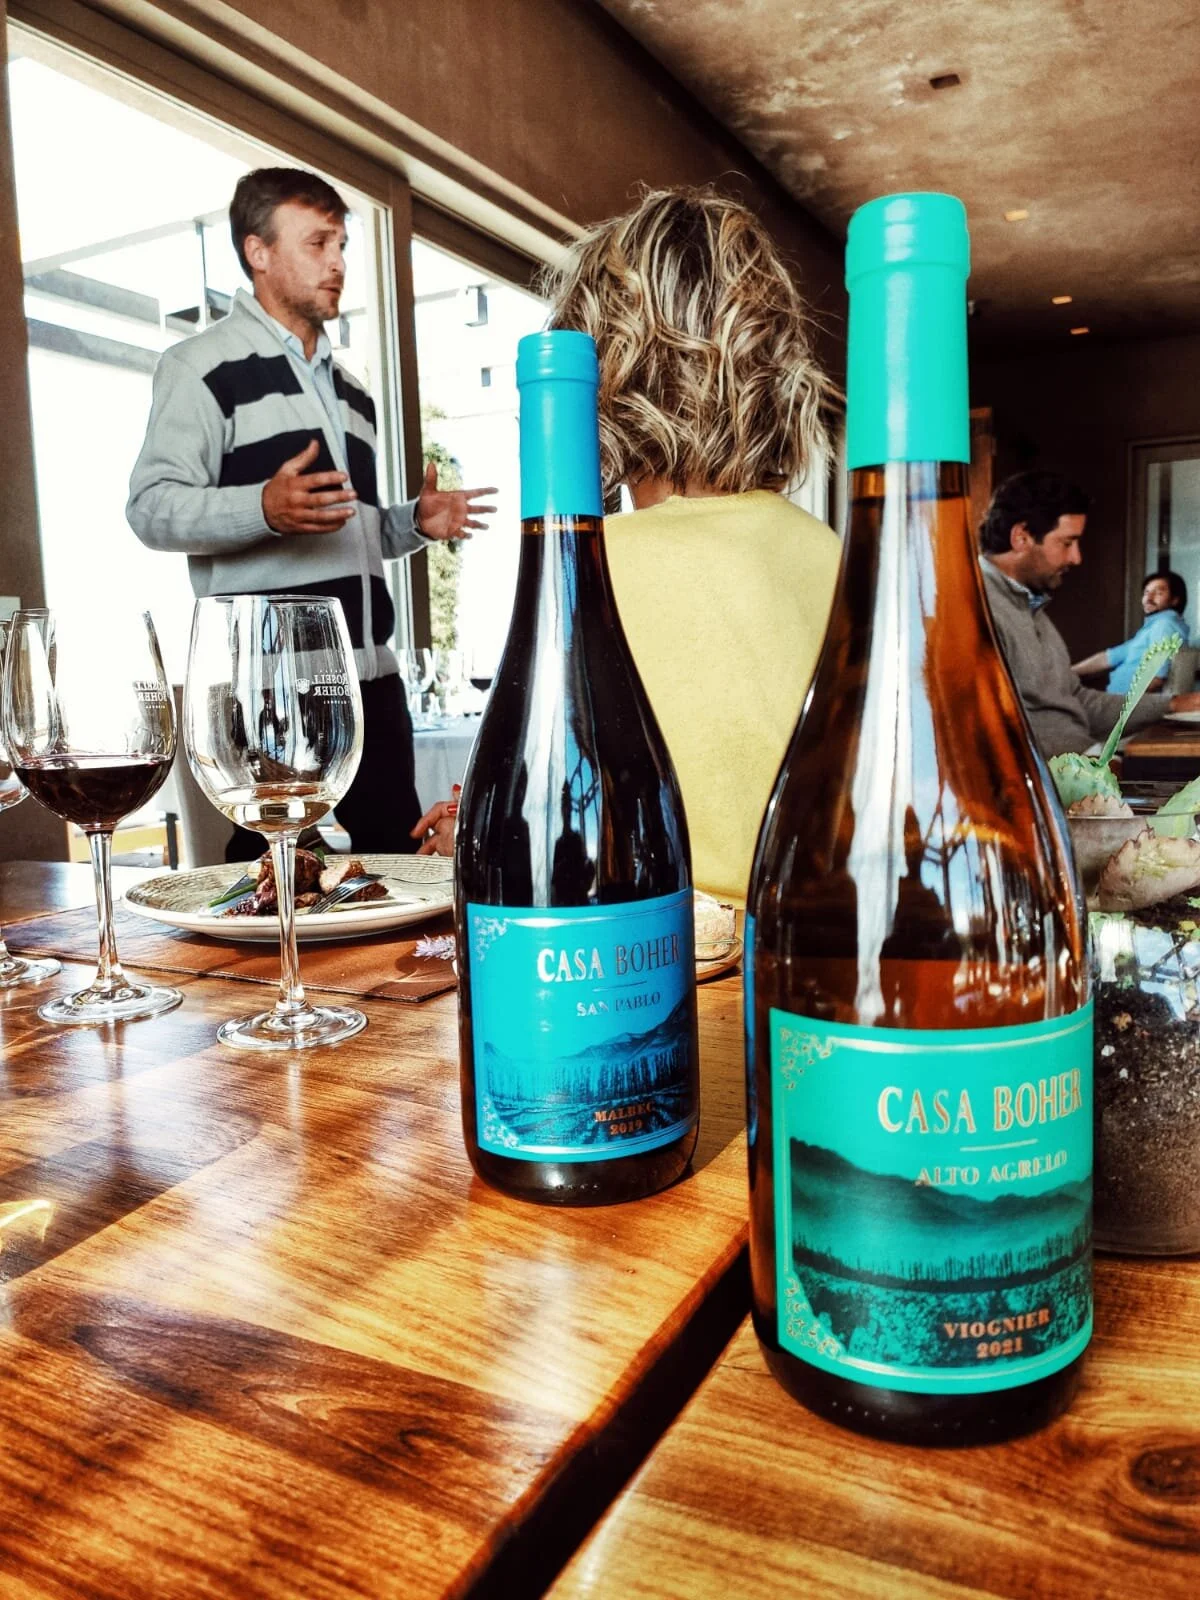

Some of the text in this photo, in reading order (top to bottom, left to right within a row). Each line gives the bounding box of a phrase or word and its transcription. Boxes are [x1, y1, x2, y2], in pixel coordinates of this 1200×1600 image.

[537, 933, 680, 982] CASA BOHER
[576, 991, 661, 1017] SAN PABLO
[595, 1102, 654, 1122] MALBEC
[877, 1068, 1083, 1133] CASA BOHER
[914, 1149, 1068, 1186] ALTO AGRELO
[944, 1308, 1049, 1339] VIOGNIER
[976, 1336, 1023, 1359] 2021
